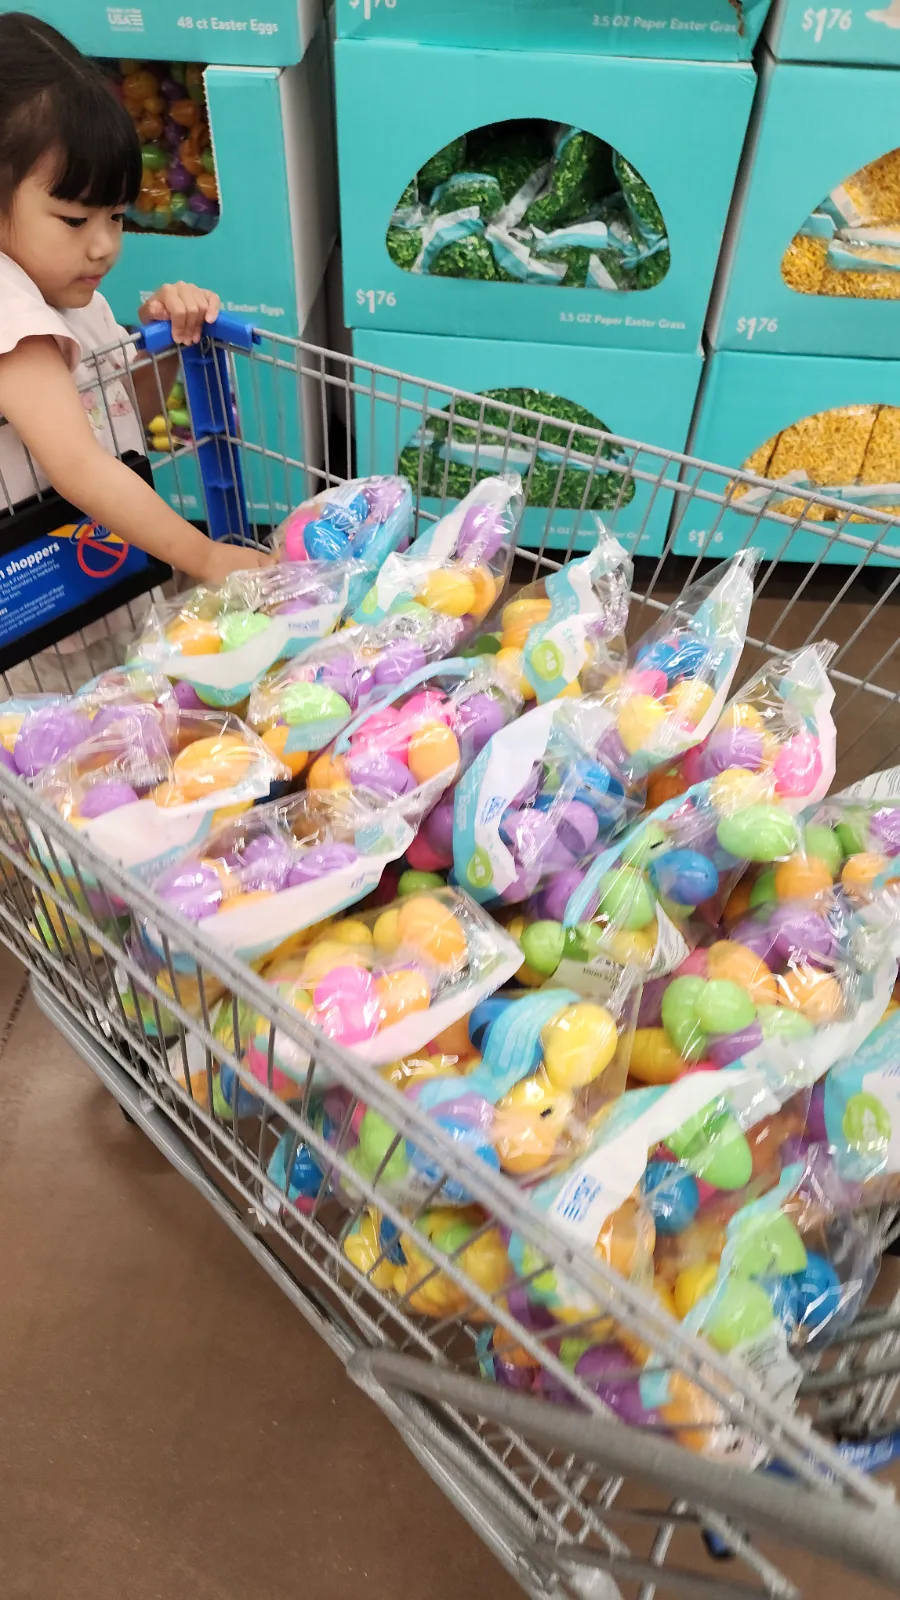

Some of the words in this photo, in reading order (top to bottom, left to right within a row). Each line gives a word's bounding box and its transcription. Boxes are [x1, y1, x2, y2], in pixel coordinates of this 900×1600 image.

[177, 16, 194, 29] 48
[196, 18, 208, 30] ct
[211, 17, 248, 31] Easter
[250, 19, 279, 35] Eggs
[633, 16, 666, 31] Paper
[670, 18, 707, 31] Easter
[260, 304, 285, 317] Eggs
[594, 314, 623, 327] Paper
[625, 316, 655, 328] Easter
[658, 319, 687, 330] Grass
[6, 541, 60, 577] shoppers
